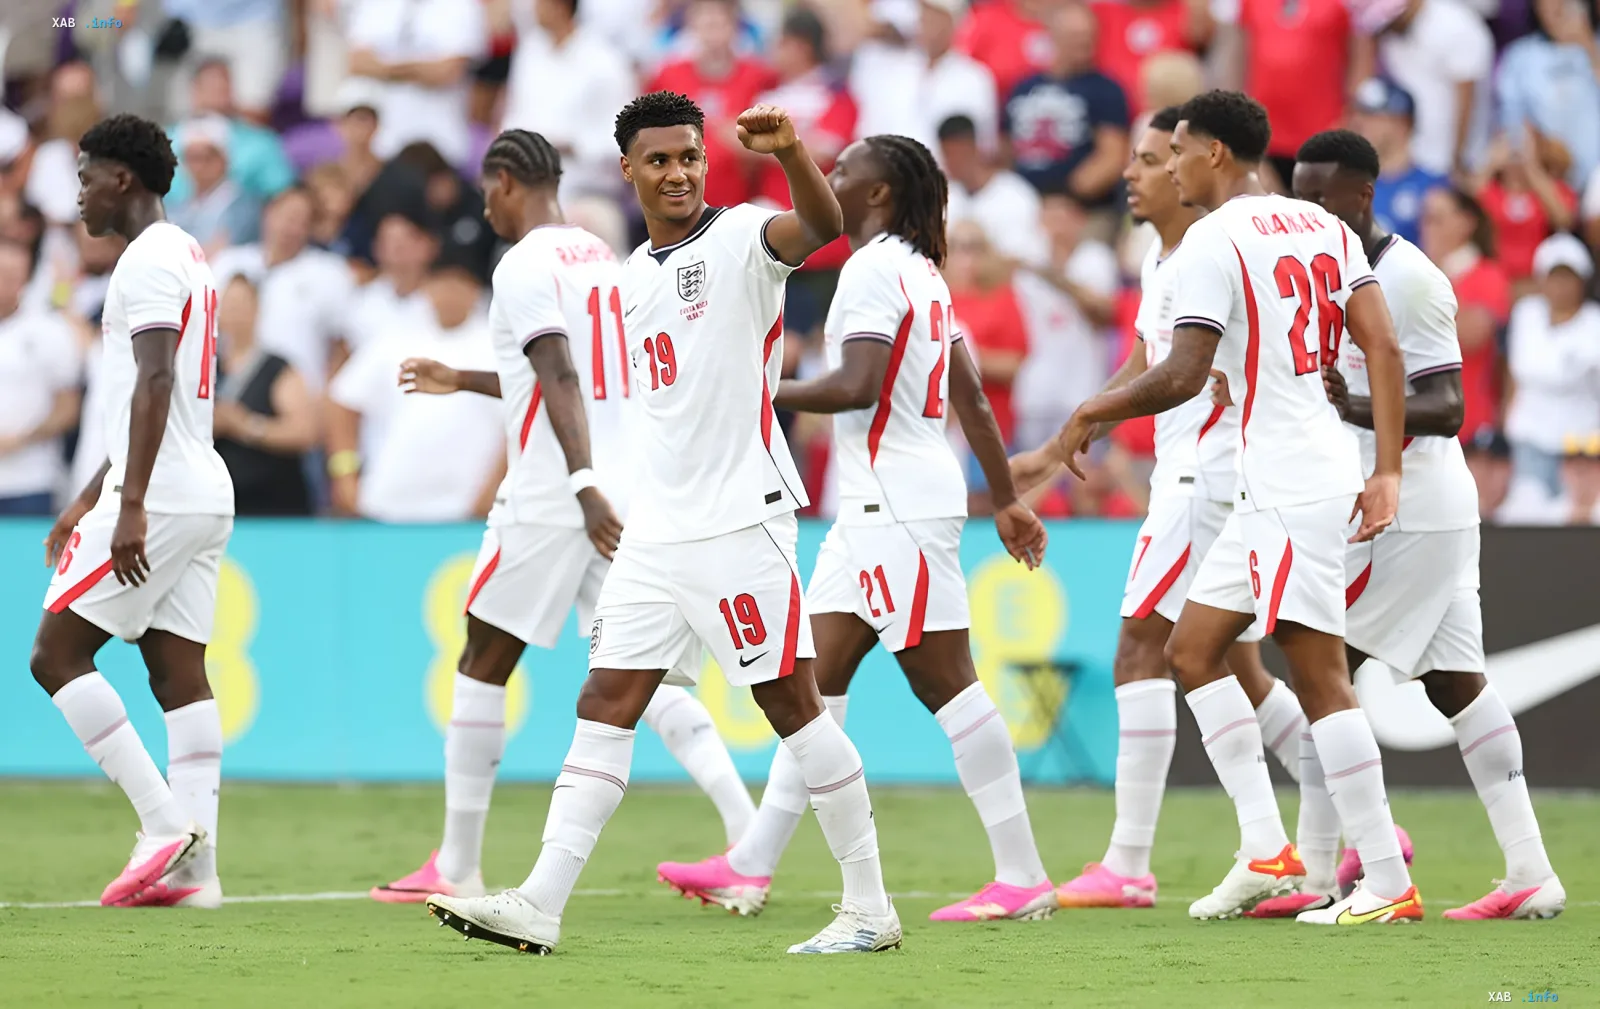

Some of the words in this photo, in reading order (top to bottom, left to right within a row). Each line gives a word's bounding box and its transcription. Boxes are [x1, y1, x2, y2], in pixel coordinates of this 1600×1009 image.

[587, 286, 629, 400] 11
[1273, 253, 1344, 377] 26
[643, 331, 677, 391] 19
[719, 592, 767, 650] 19
[859, 564, 896, 618] 21
